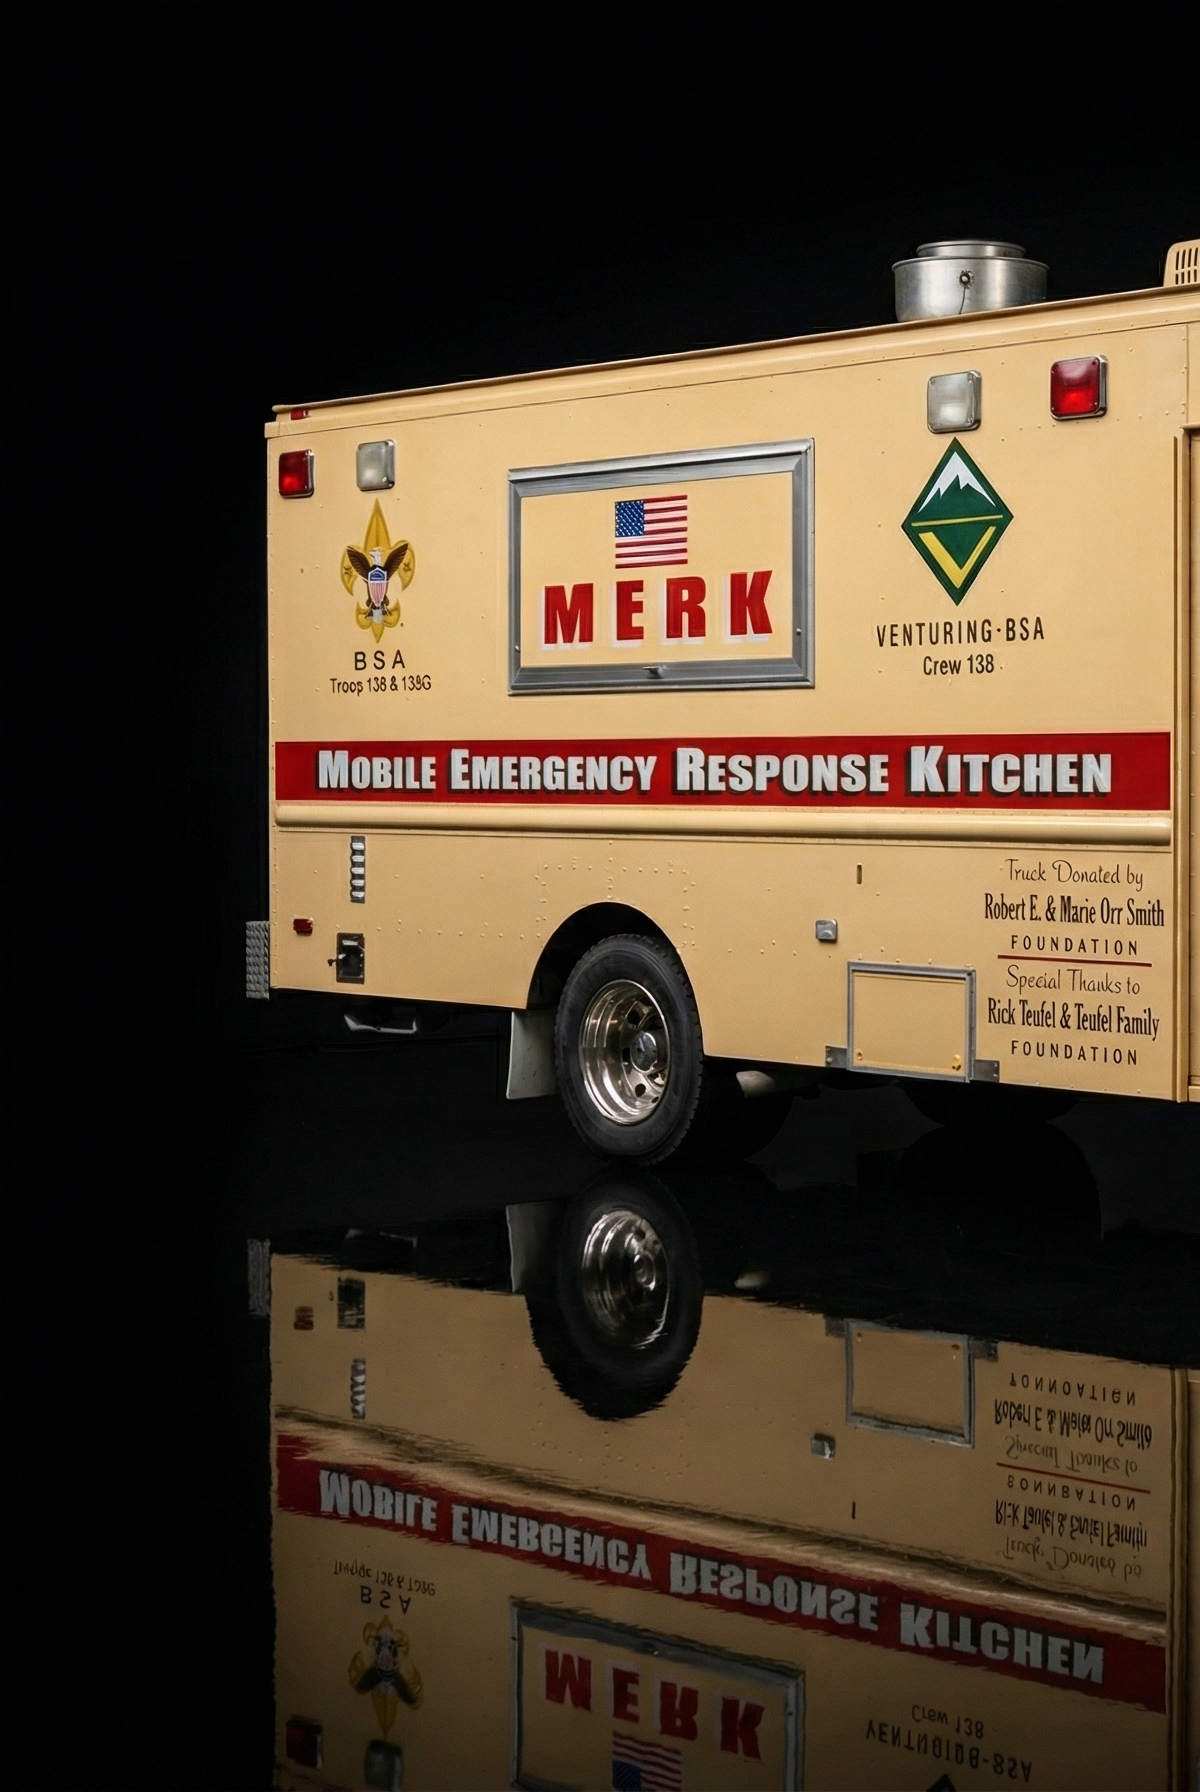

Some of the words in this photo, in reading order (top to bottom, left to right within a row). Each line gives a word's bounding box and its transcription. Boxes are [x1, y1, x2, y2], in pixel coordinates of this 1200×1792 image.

[543, 570, 773, 645] MERK
[354, 649, 406, 671] BSA
[923, 656, 962, 675] Crew
[967, 655, 995, 674] 138
[329, 678, 364, 697] Troop
[366, 676, 387, 692] 138
[389, 675, 399, 691] &
[1005, 858, 1047, 881] Truck
[1052, 859, 1121, 884] Donated
[1126, 864, 1143, 892] by
[984, 893, 1026, 920] Robert
[1030, 894, 1042, 921] E.
[1045, 895, 1057, 922] &
[1060, 895, 1096, 924] Marie
[1100, 897, 1123, 925] Orr
[1127, 898, 1164, 927] Smith
[1011, 935, 1137, 956] FOUNDATION
[1006, 964, 1061, 995] Special
[1066, 968, 1122, 994] Thanks
[1126, 976, 1141, 995] to
[987, 997, 1016, 1025] Rick
[1019, 999, 1056, 1028] Teufel
[1060, 1002, 1071, 1029] &
[1074, 1003, 1112, 1033] Teufel
[1116, 1006, 1160, 1042] Family
[1011, 1040, 1137, 1065] FOUNDATION
